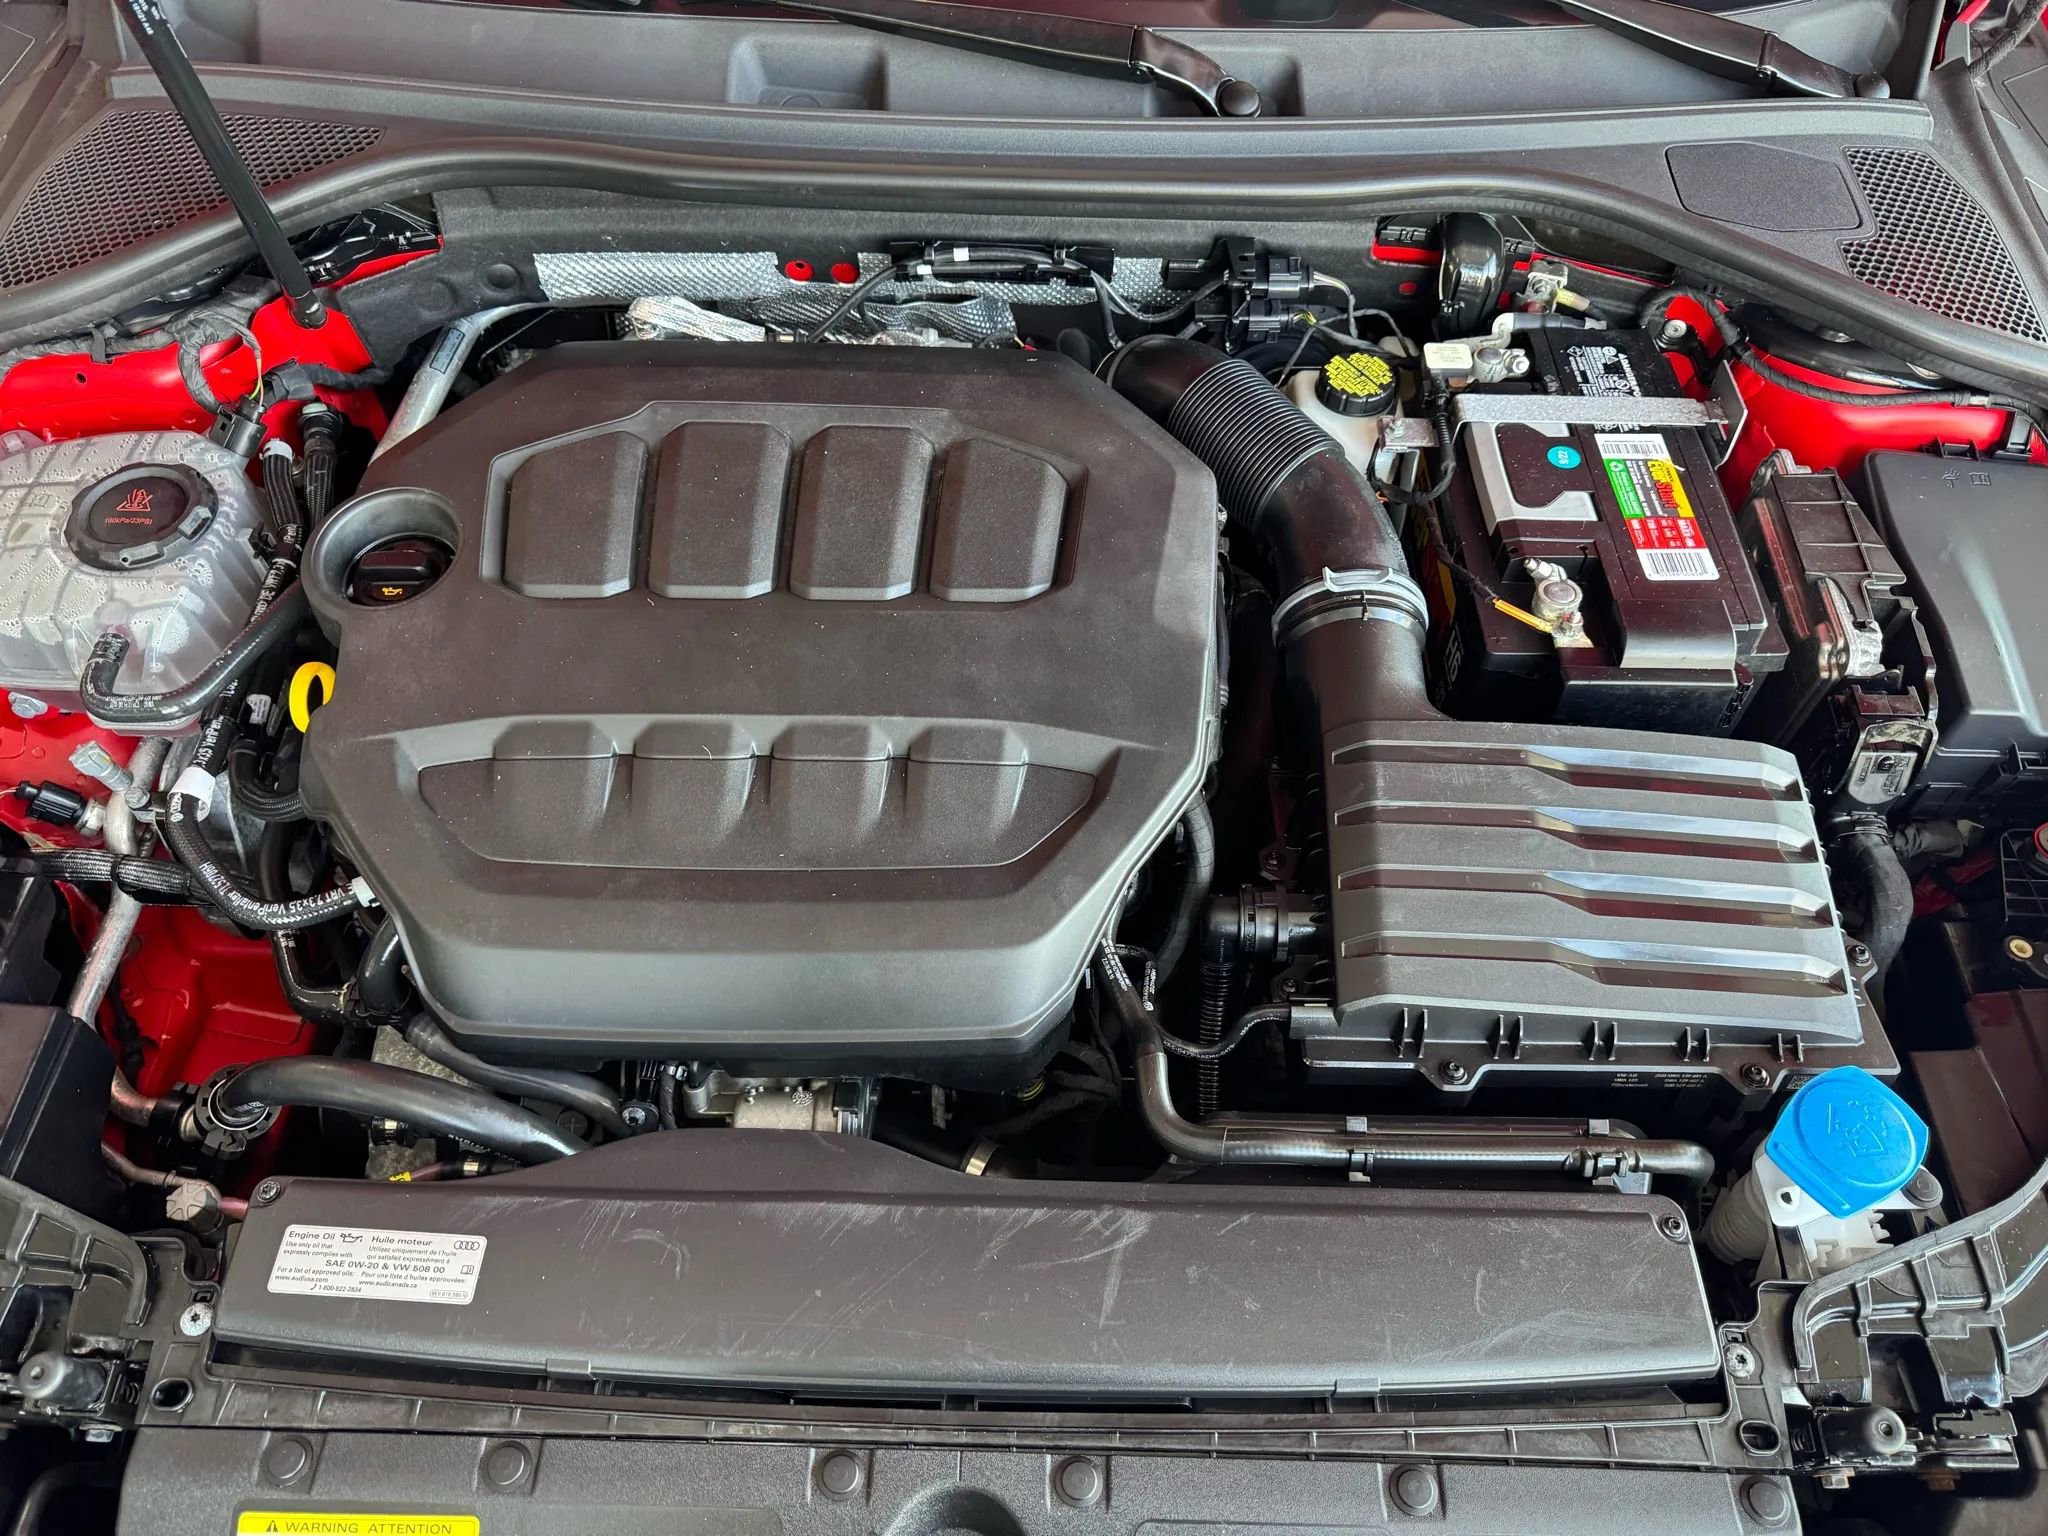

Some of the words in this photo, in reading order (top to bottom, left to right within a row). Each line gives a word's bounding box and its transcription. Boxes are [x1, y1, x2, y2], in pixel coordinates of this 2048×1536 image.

[1645, 460, 1681, 509] EverStart
[324, 887, 346, 905] VRT
[227, 890, 286, 916] VeriPentaflex
[289, 1230, 320, 1240] Engine
[323, 1232, 335, 1240] Oil
[371, 1235, 395, 1244] Huile
[397, 1238, 433, 1246] moteur
[392, 1247, 428, 1255] uniquement
[325, 1259, 346, 1267] SAE
[348, 1261, 379, 1269] 0W-20
[393, 1263, 411, 1271] VW
[413, 1265, 430, 1273] 508
[402, 1256, 443, 1264] expressément
[359, 1280, 417, 1288] www.audicanada.ca
[286, 1521, 358, 1534] WARNING
[368, 1522, 452, 1535] ATTENTION
